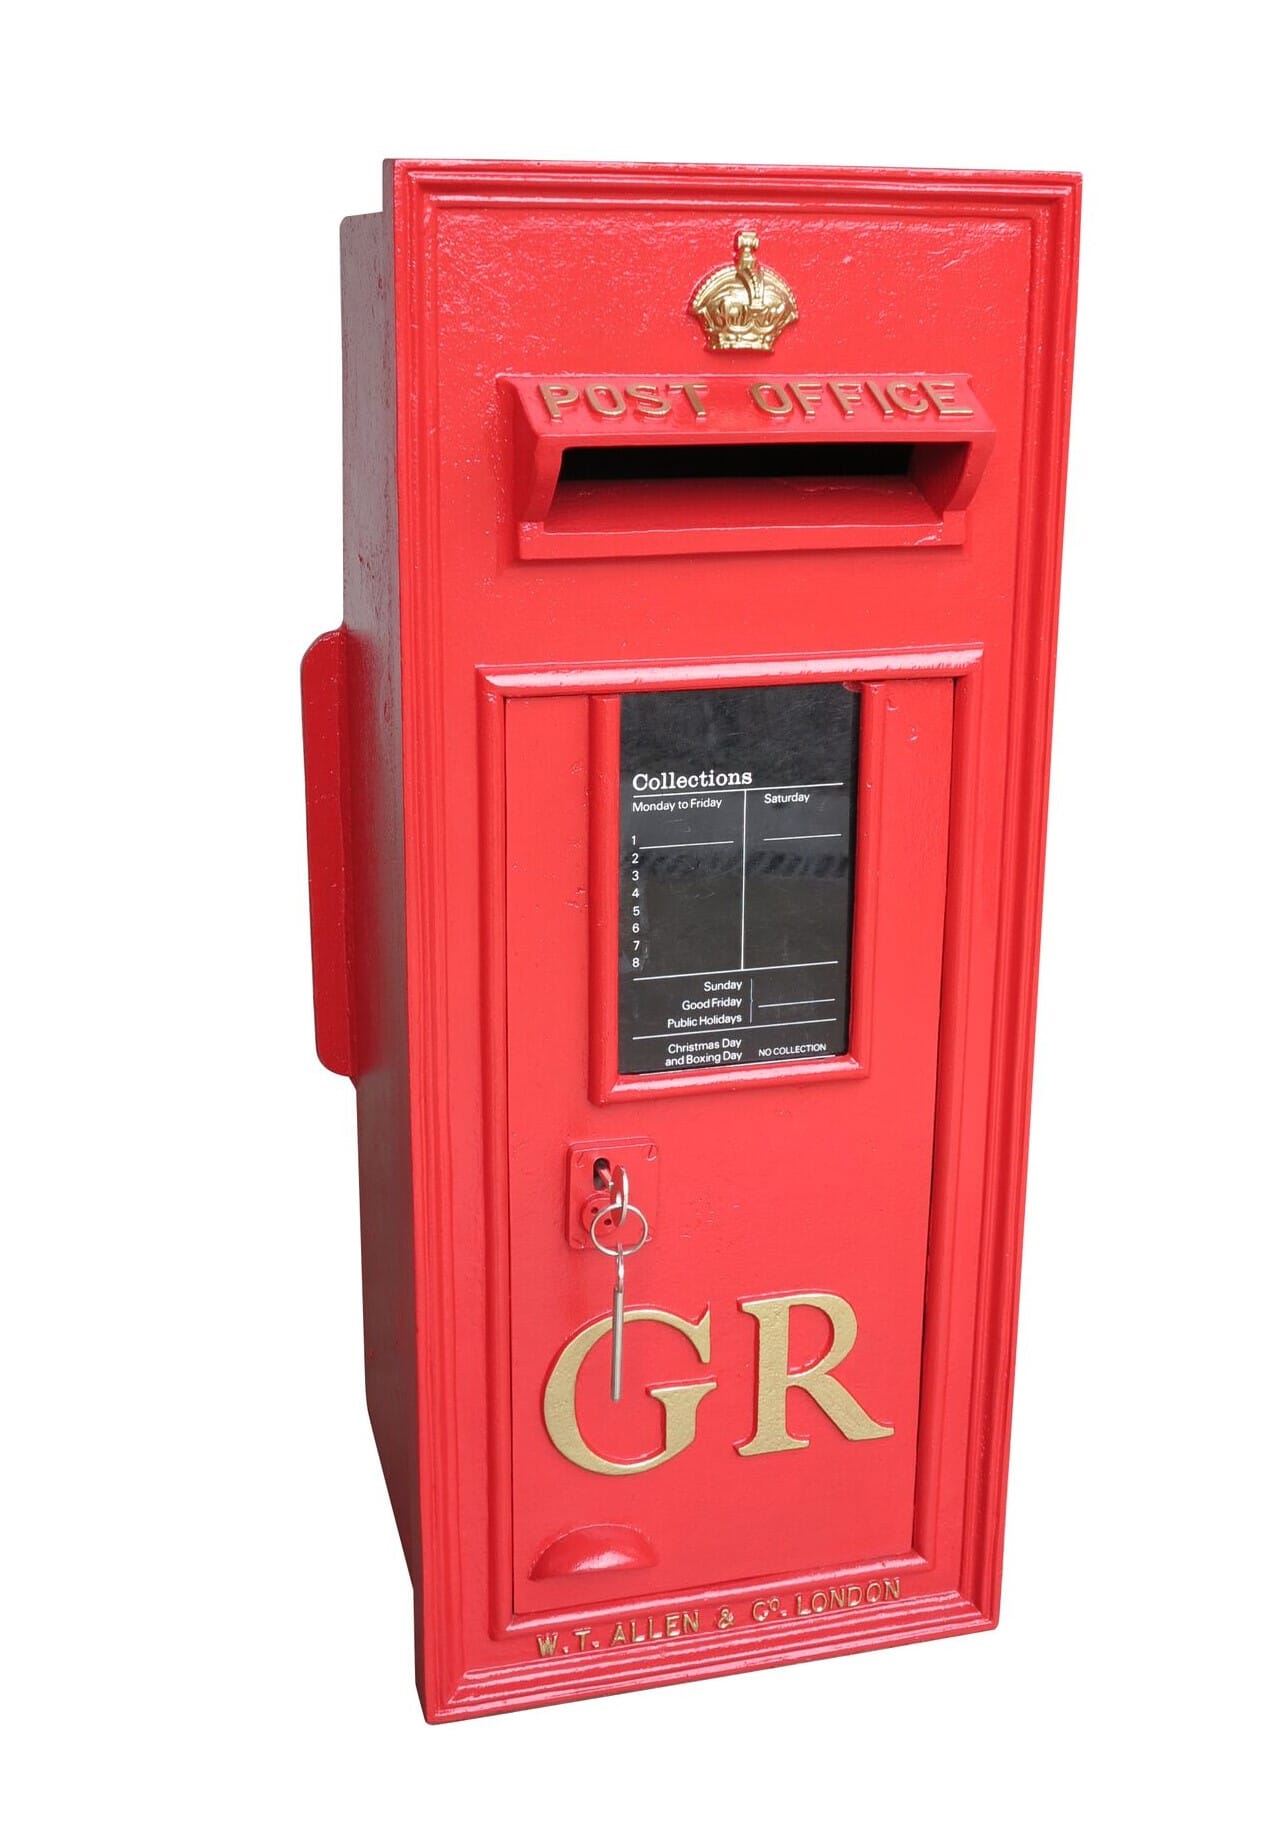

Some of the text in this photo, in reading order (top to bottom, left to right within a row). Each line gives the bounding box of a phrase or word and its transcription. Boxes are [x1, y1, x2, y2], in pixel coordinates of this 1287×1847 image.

[537, 381, 975, 422] POST OFFICE
[632, 769, 752, 791] Collections
[764, 792, 810, 804] Saturday
[632, 797, 722, 813] Monday to Friday
[631, 835, 637, 845] 1
[632, 853, 639, 864] 2
[632, 871, 639, 881] 3
[631, 888, 640, 898] 4
[633, 906, 640, 917] 5
[632, 923, 640, 933] 6
[633, 941, 640, 951] 7
[632, 958, 640, 968] 8
[704, 980, 743, 993] Sunday
[682, 997, 742, 1011] Good Friday
[667, 1013, 742, 1029] Public Holidays
[668, 1037, 742, 1054] Christmas Day
[758, 1043, 827, 1057] NO COLLECTION
[665, 1050, 743, 1067] and Boxing Day
[543, 1291, 895, 1476] GR
[610, 1611, 700, 1646] ALLEN
[716, 1606, 735, 1630] &
[796, 1577, 901, 1616] LONDON
